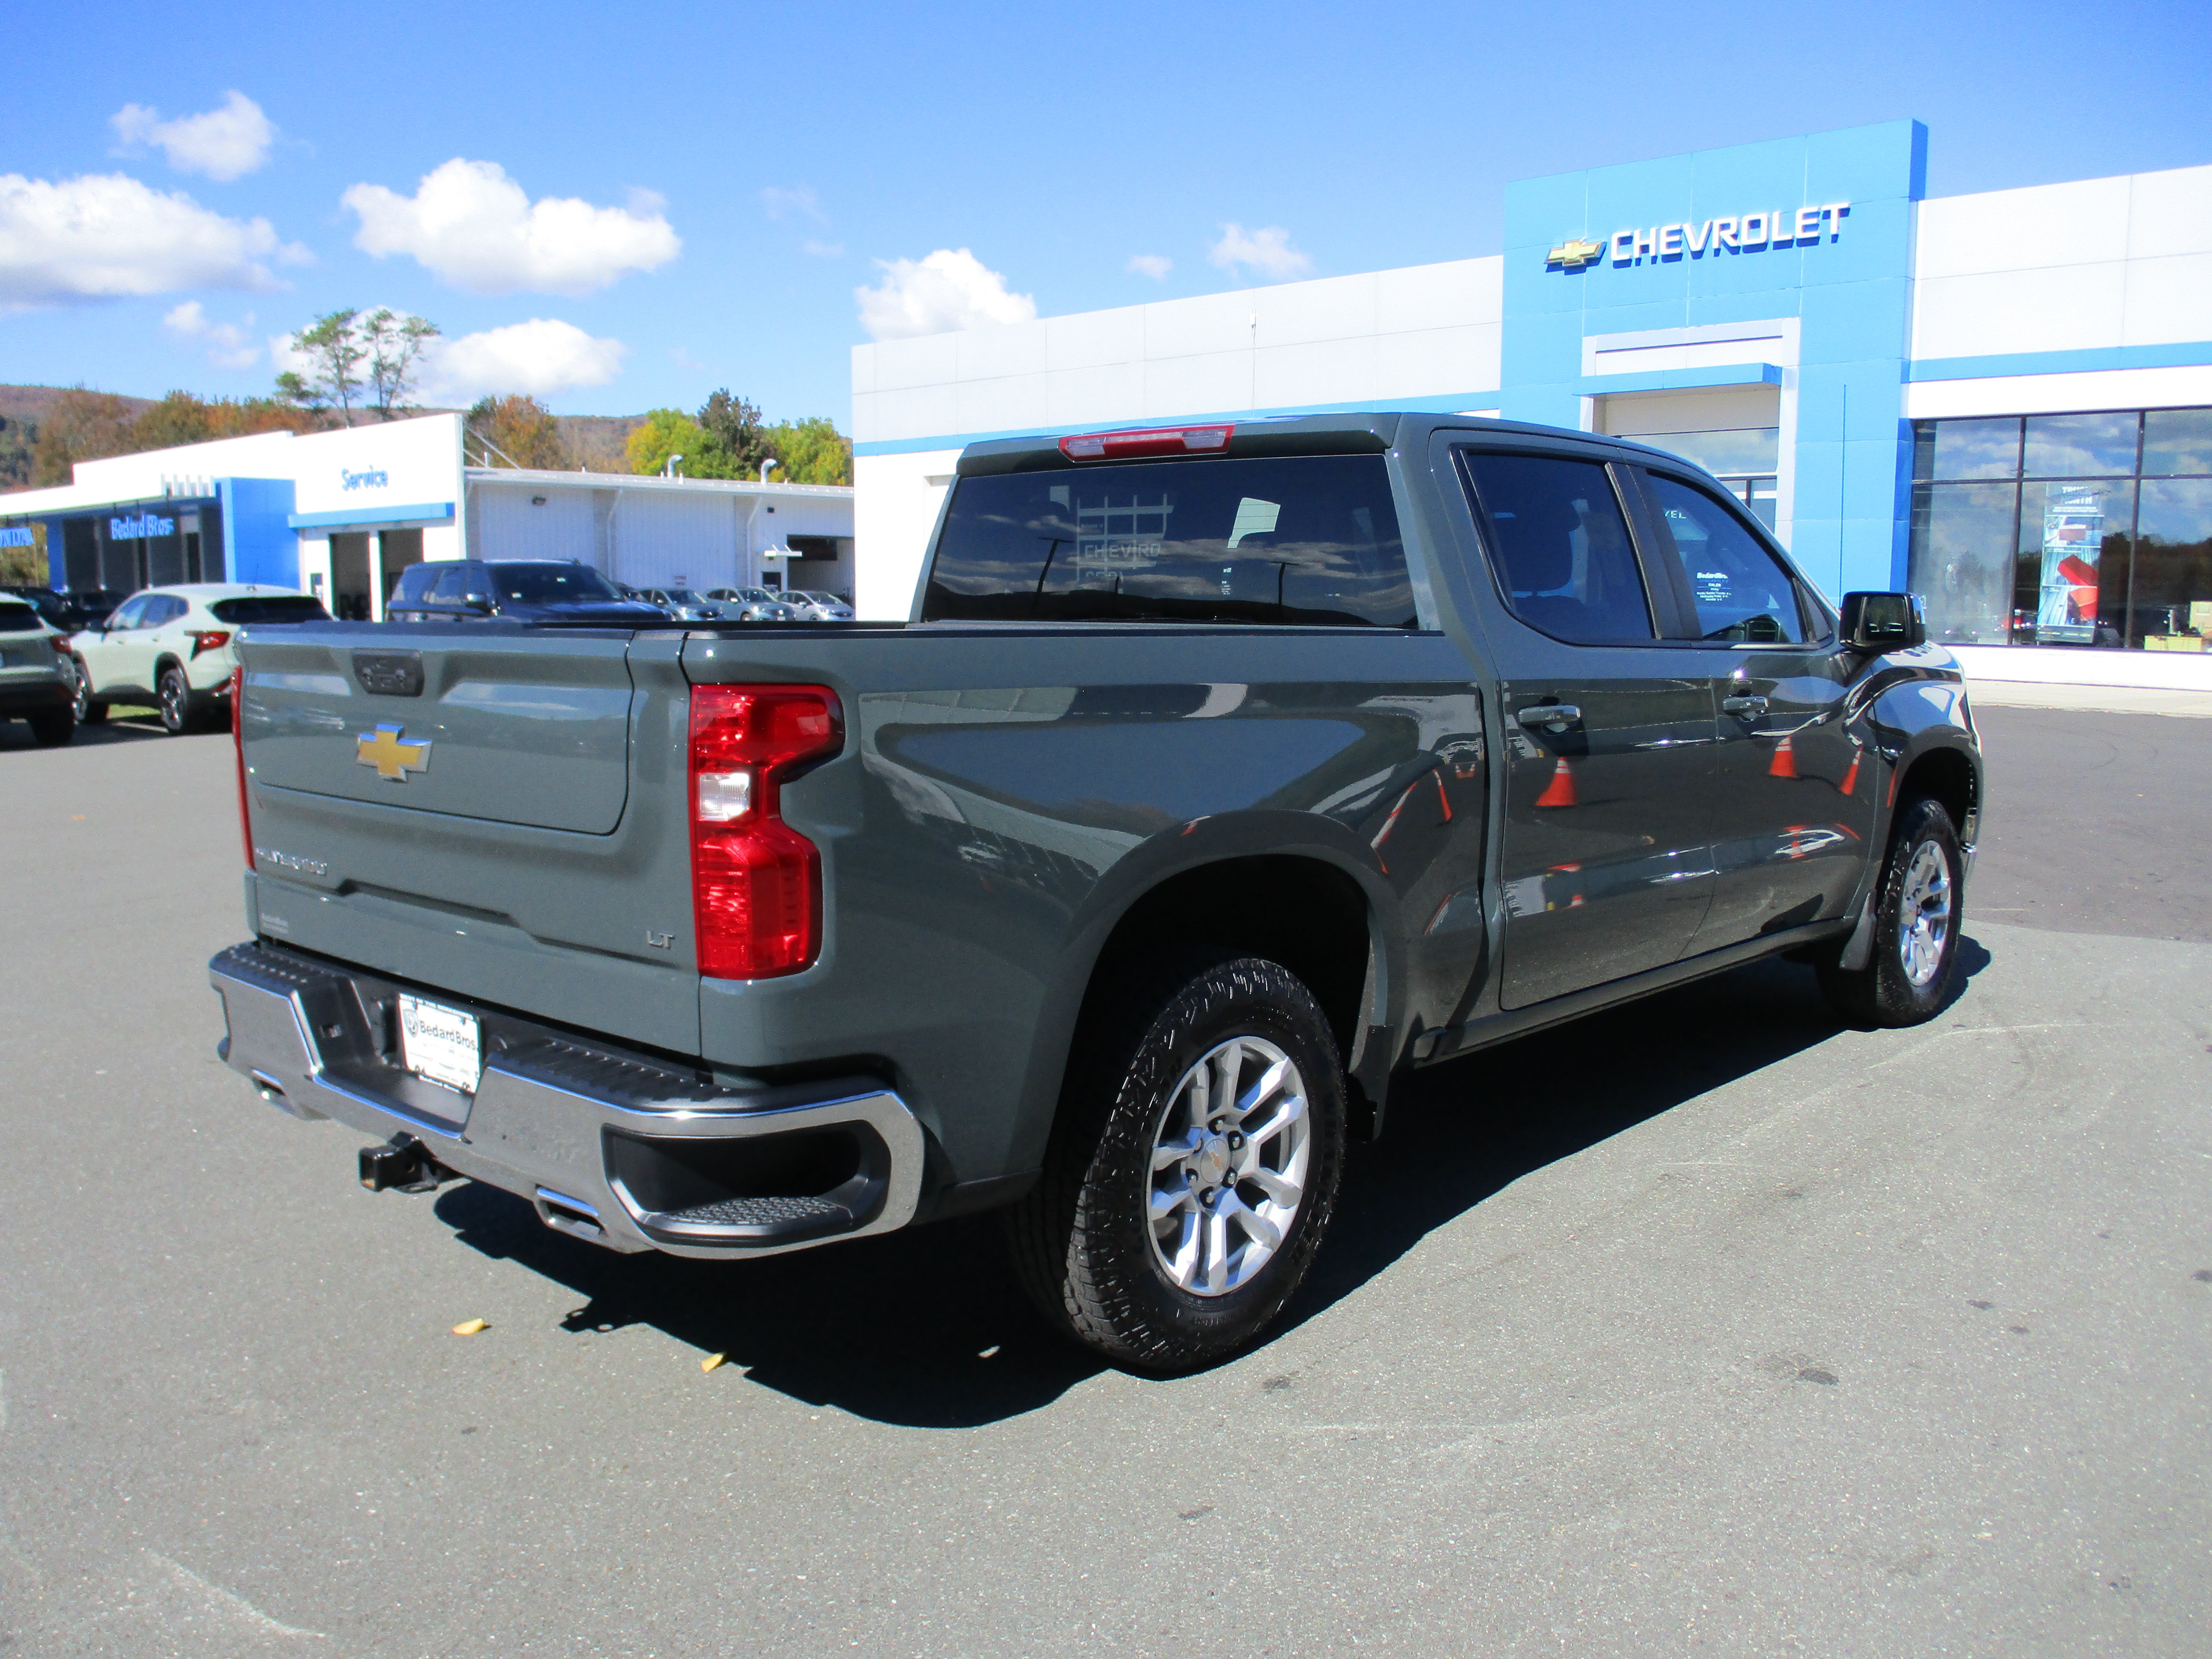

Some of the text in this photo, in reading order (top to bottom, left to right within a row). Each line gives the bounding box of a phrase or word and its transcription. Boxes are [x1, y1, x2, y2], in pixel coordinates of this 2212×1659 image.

[1611, 202, 1850, 261] CHEVROLET
[341, 464, 389, 491] Service
[646, 930, 675, 948] LT
